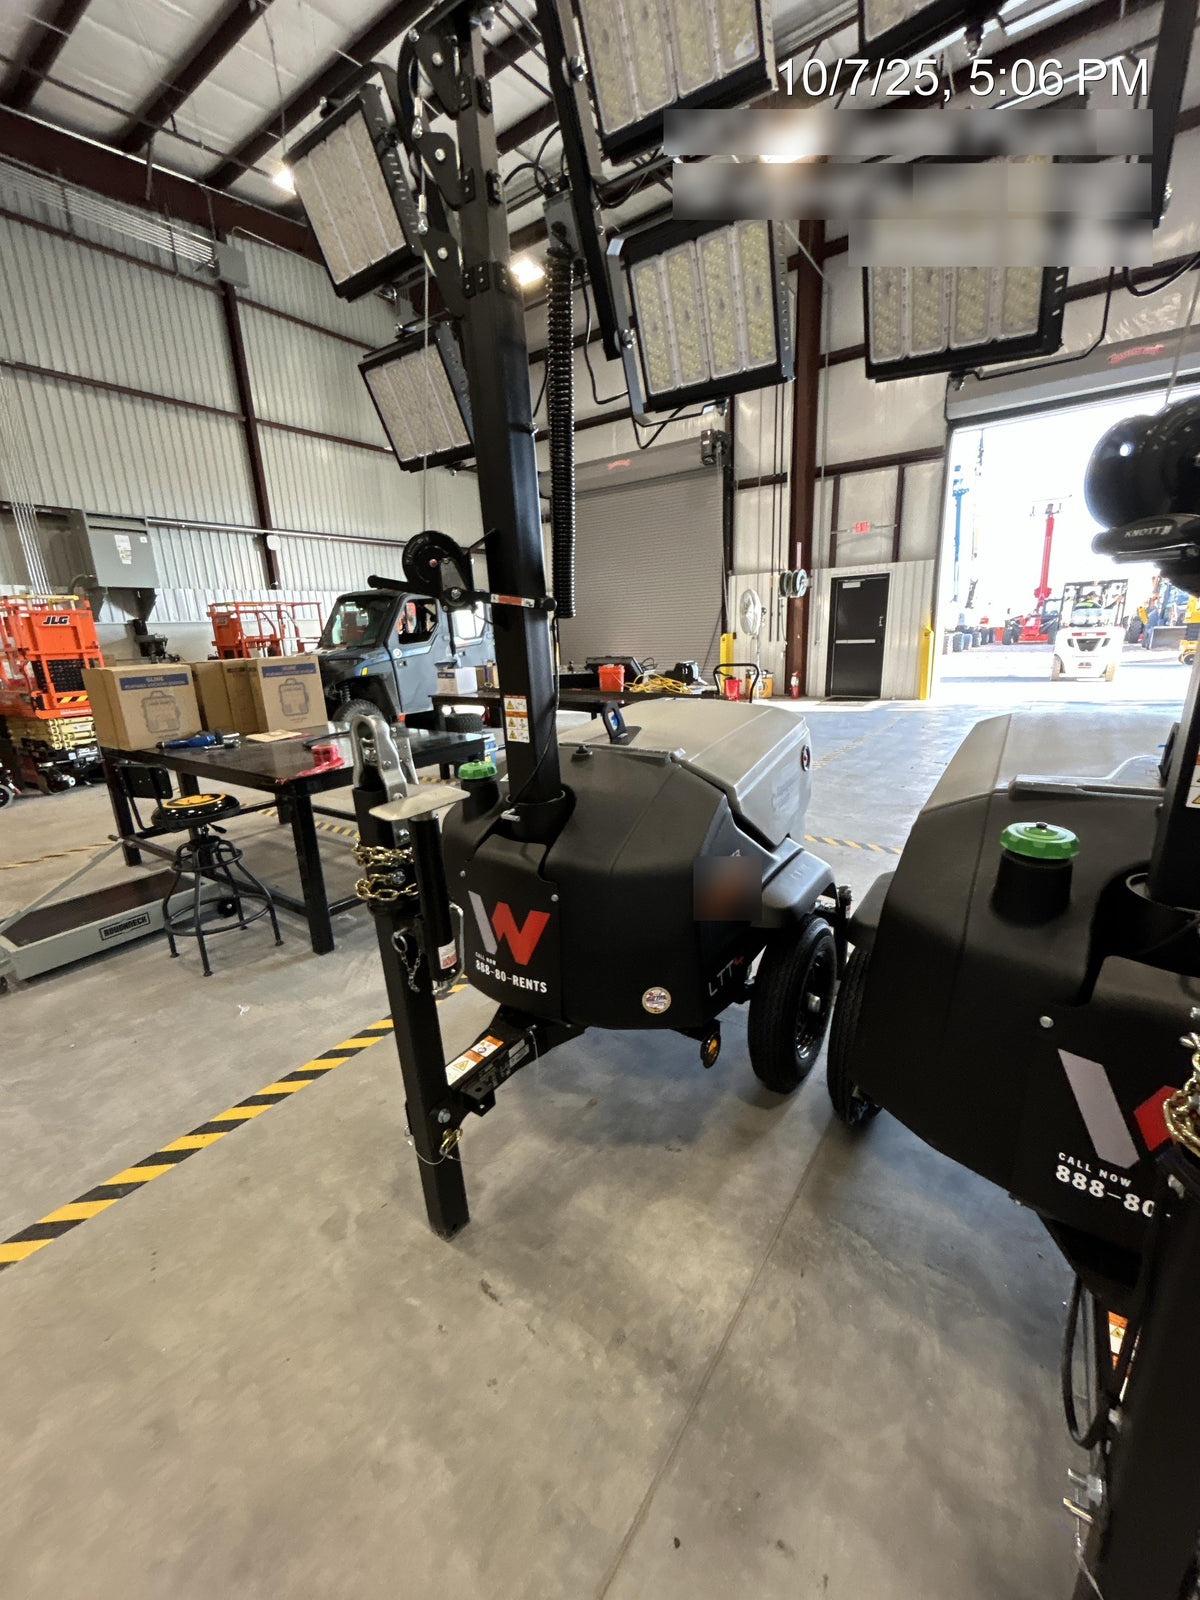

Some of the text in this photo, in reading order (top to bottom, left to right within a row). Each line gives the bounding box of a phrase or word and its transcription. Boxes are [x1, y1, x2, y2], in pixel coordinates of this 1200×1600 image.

[1124, 526, 1164, 538] KNOTT
[42, 615, 69, 625] JLG
[475, 959, 548, 993] 888-80-RENTS
[1058, 1152, 1132, 1188] CALL NOW
